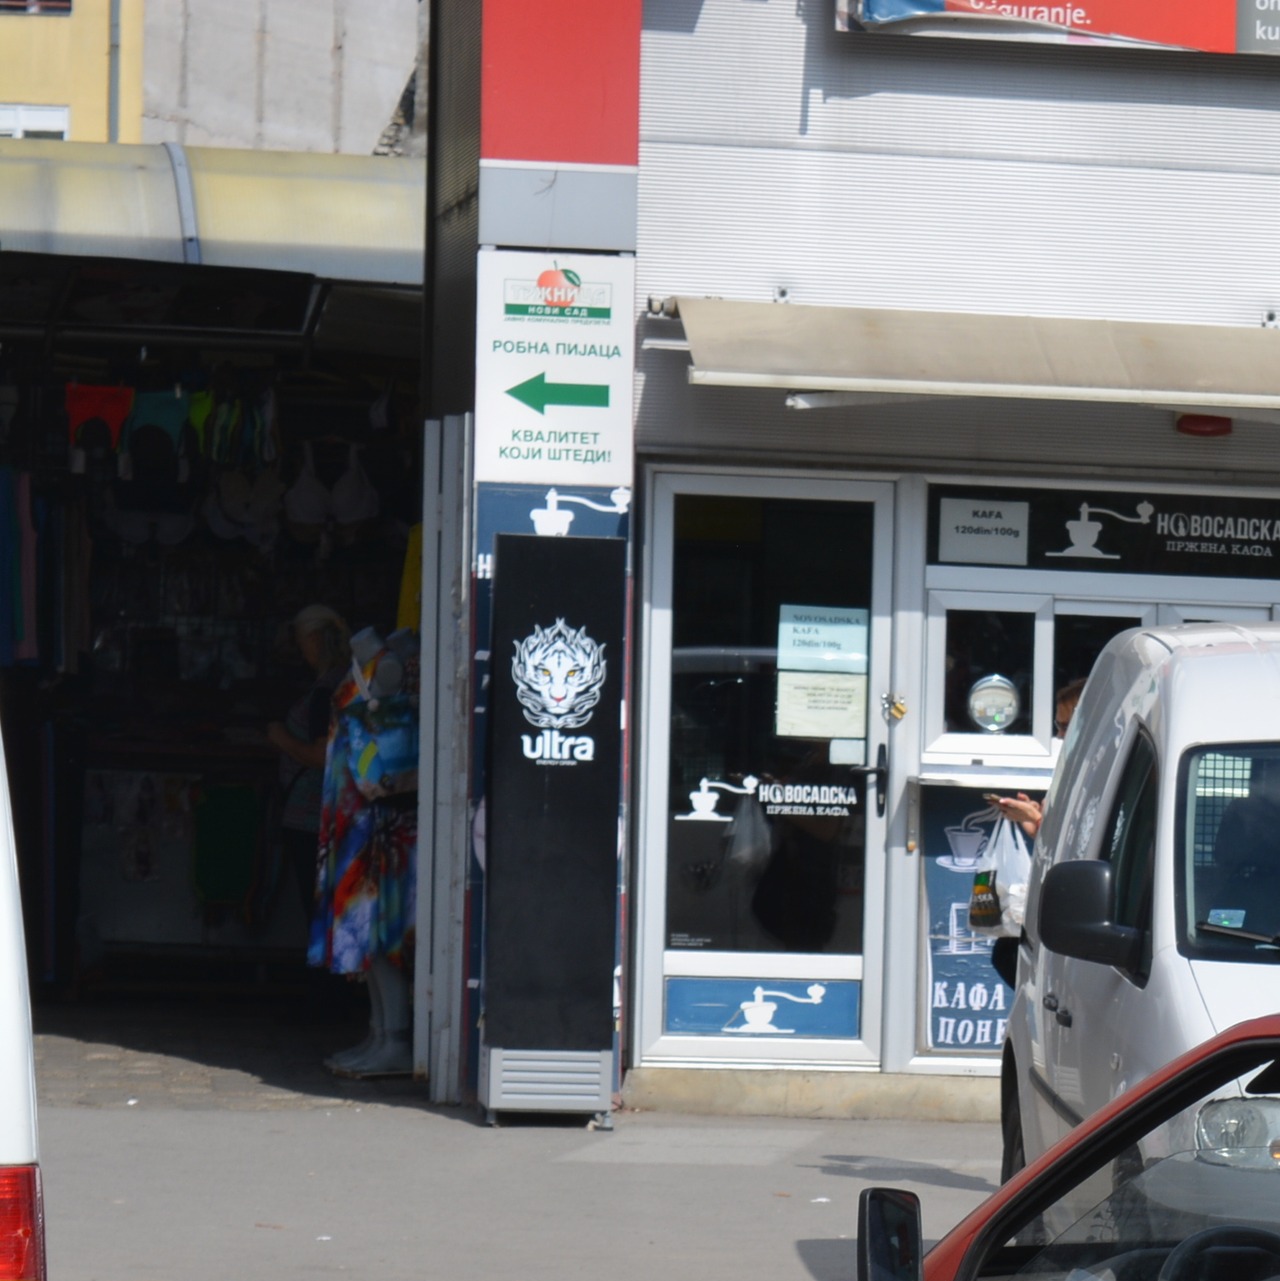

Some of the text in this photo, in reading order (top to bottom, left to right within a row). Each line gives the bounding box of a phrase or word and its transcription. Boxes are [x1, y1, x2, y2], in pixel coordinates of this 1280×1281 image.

[528, 306, 589, 317] НОВИ САД
[493, 340, 622, 359] РОБНА ПИЈАЦА
[511, 430, 601, 445] КВАЛИТЕТ
[499, 447, 612, 464] КОЈИ ШТЕДИ!
[971, 509, 1004, 520] KAFA
[954, 525, 1020, 539] 120din/100g
[1166, 541, 1273, 557] ПРЖЕНА КАФА
[792, 626, 819, 635] KAFA
[521, 730, 594, 761] ultra
[758, 784, 857, 805] НОВОСАДСКА
[766, 805, 849, 817] ПРЖЕНА КАФА
[933, 981, 1006, 1010] КАФА
